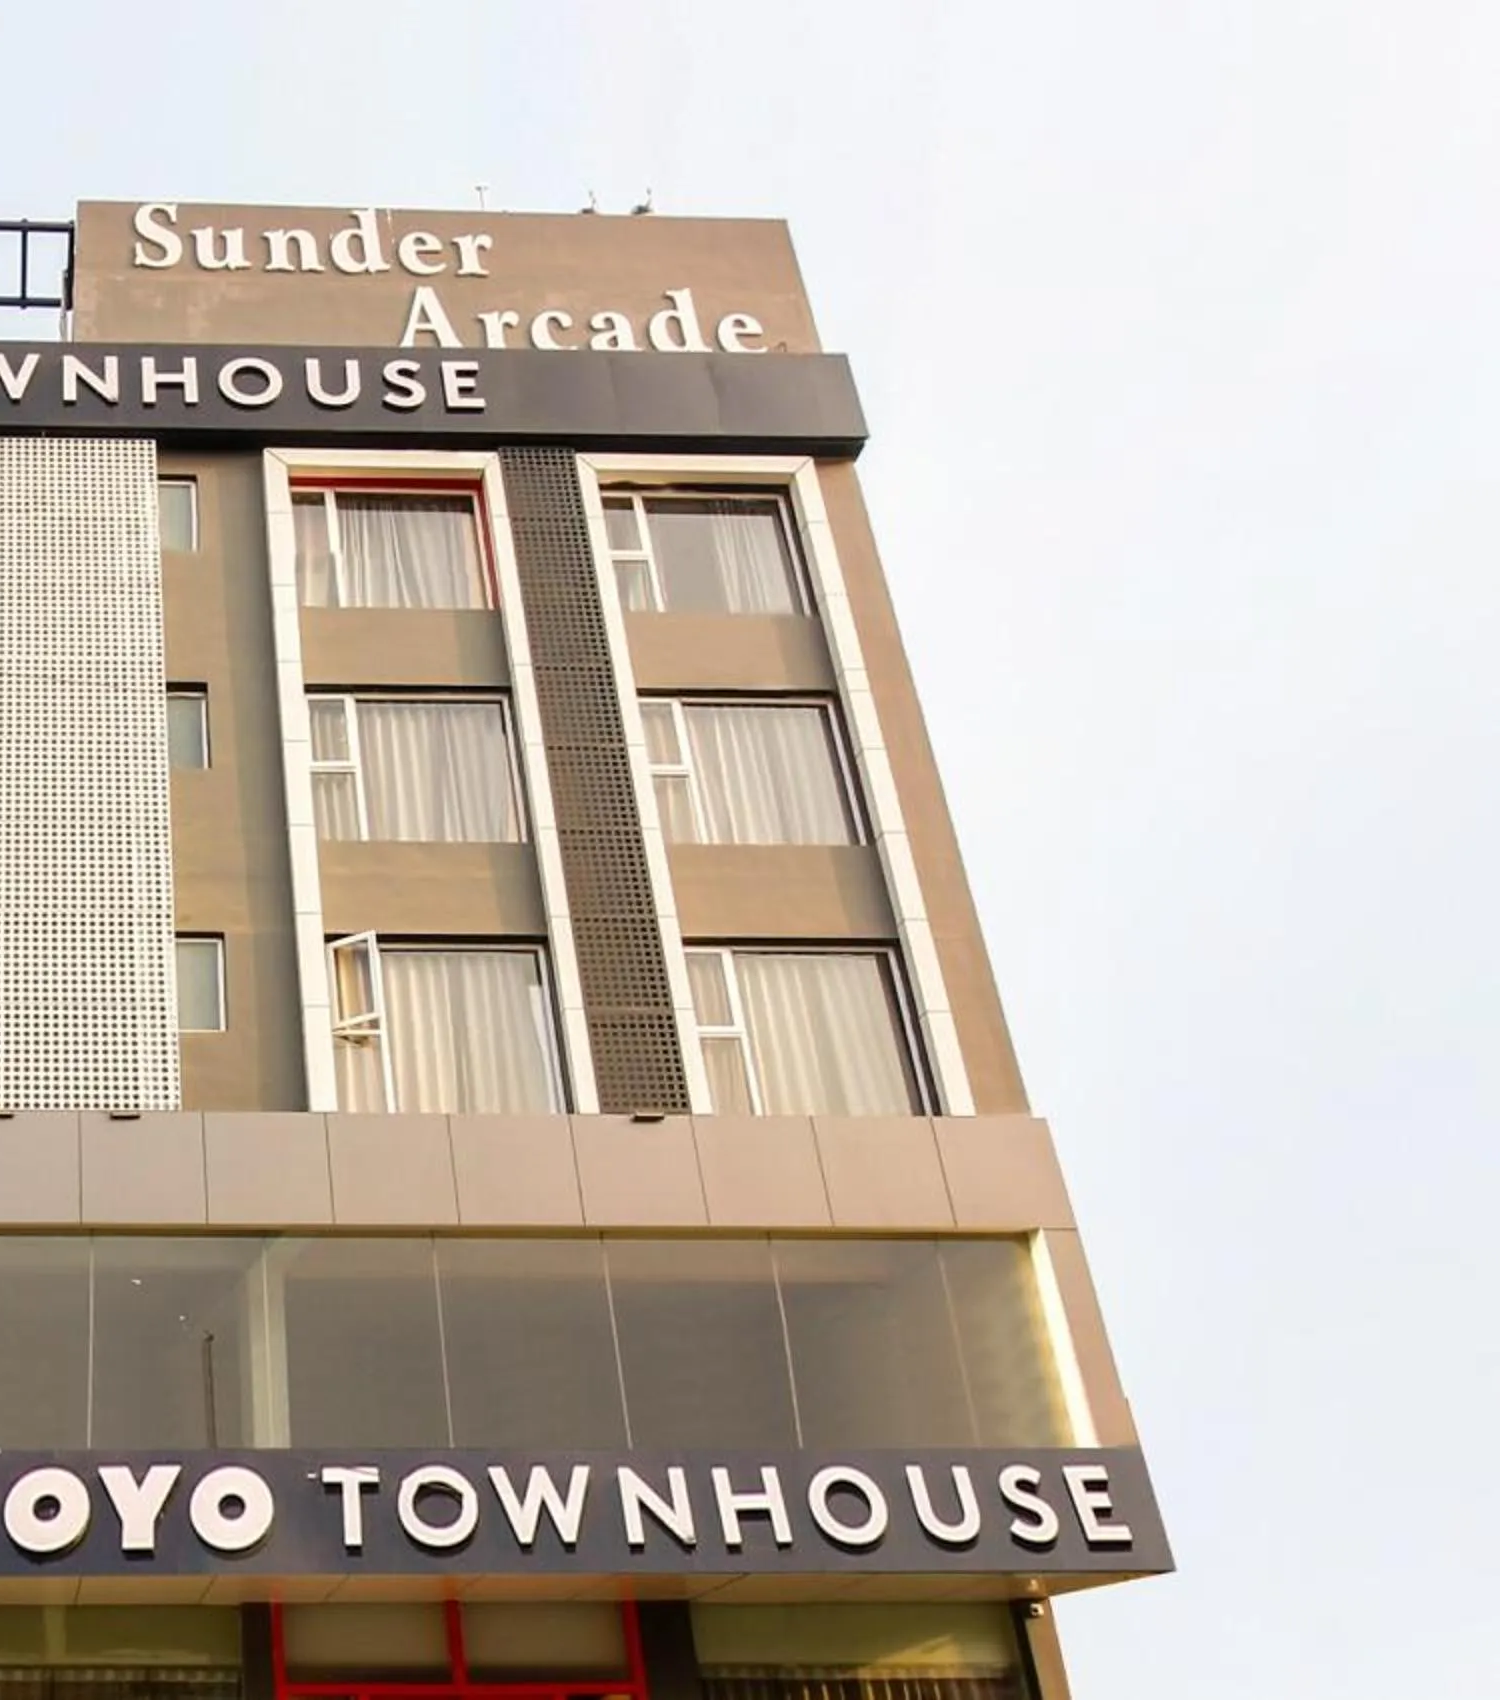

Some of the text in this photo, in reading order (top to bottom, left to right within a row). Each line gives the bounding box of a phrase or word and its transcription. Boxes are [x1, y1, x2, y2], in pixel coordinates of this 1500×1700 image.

[132, 203, 493, 278] Sunder
[399, 286, 771, 354] Arcade
[3, 1464, 1134, 1554] OYO TOWNHOUSE
